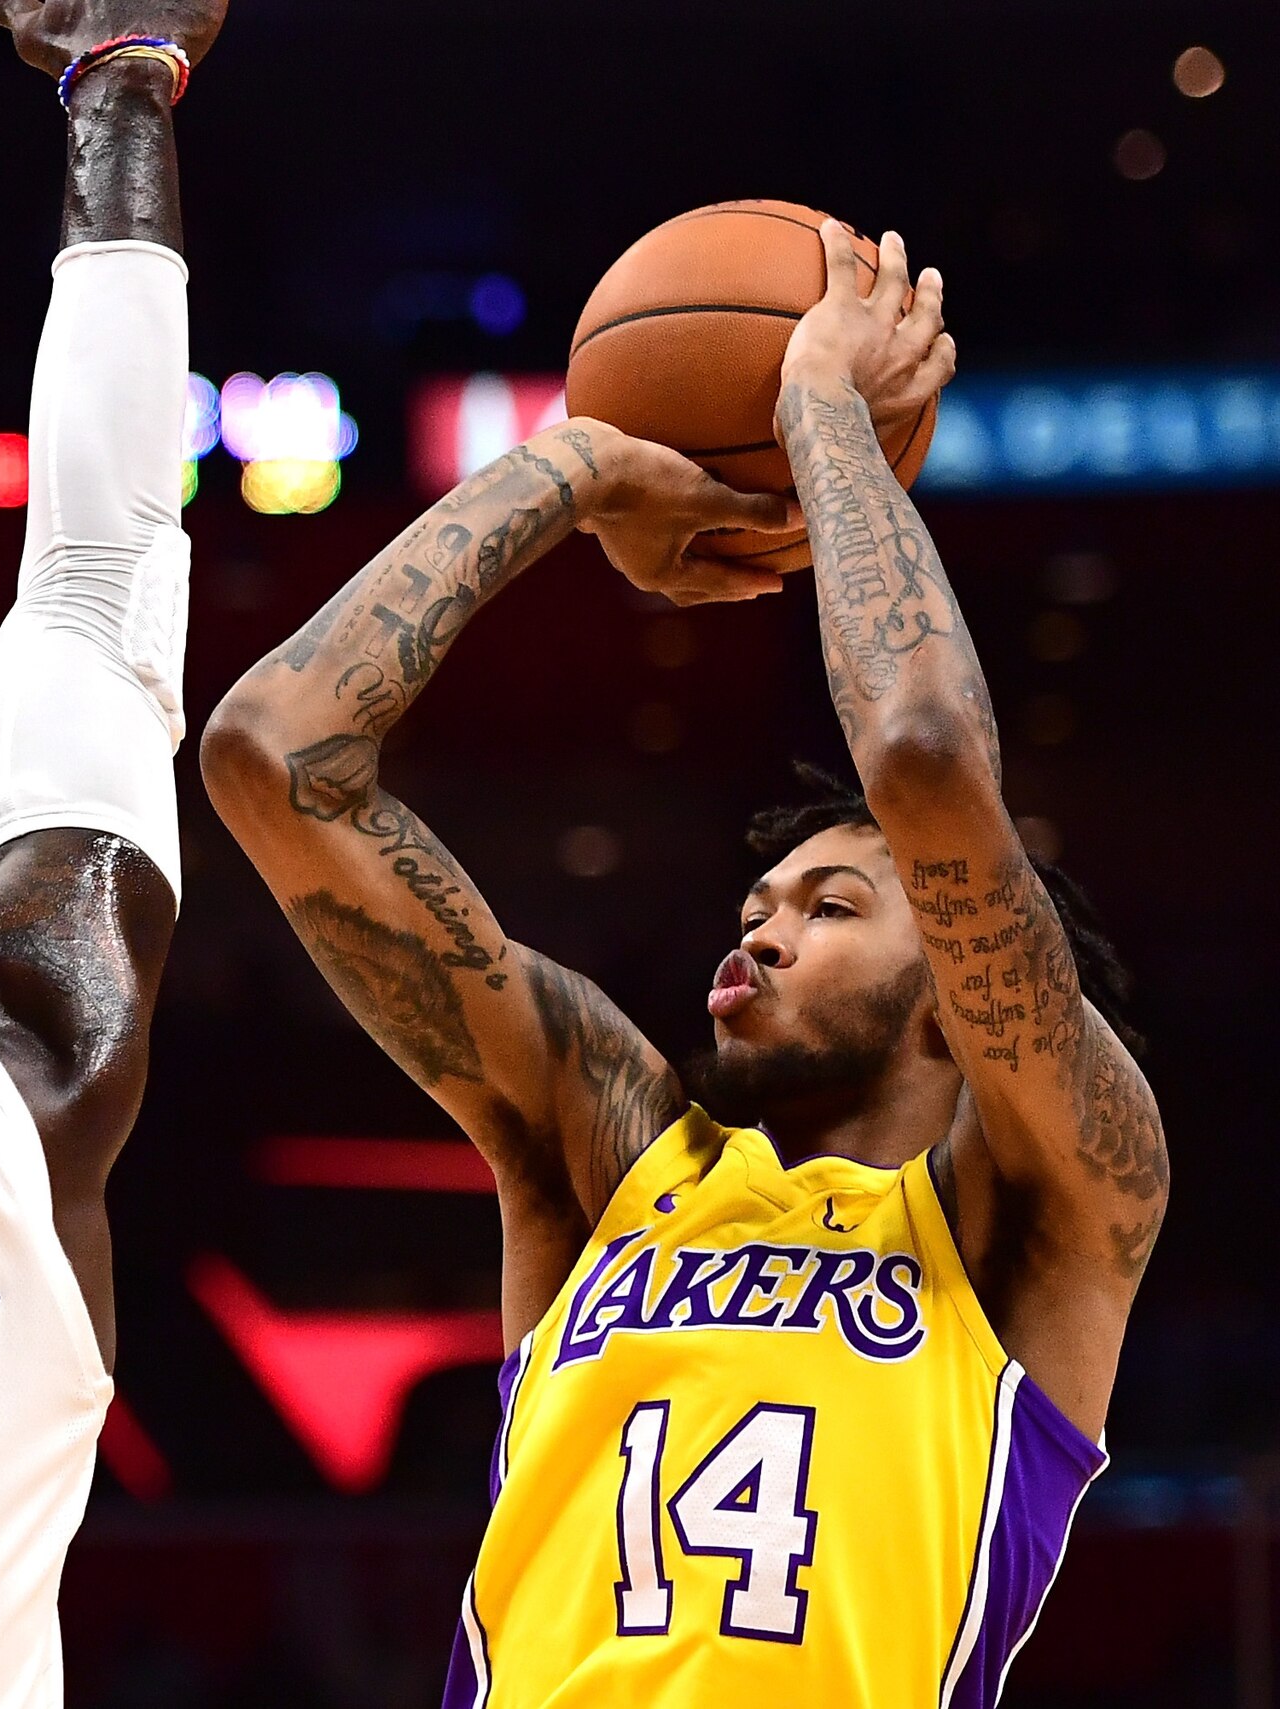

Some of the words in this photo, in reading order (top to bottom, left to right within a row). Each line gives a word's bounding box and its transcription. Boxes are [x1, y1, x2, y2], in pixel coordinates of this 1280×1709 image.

[911, 859, 969, 889] itself
[350, 806, 509, 991] Nothing's
[985, 881, 1016, 912] the
[972, 921, 1033, 955] worse
[961, 964, 990, 1000] far
[1002, 968, 1022, 993] is
[950, 990, 1025, 1036] suffering
[1032, 982, 1049, 1025] of
[983, 1036, 1020, 1072] fear
[550, 1226, 928, 1376] LAKERS
[613, 1399, 818, 1645] 14
